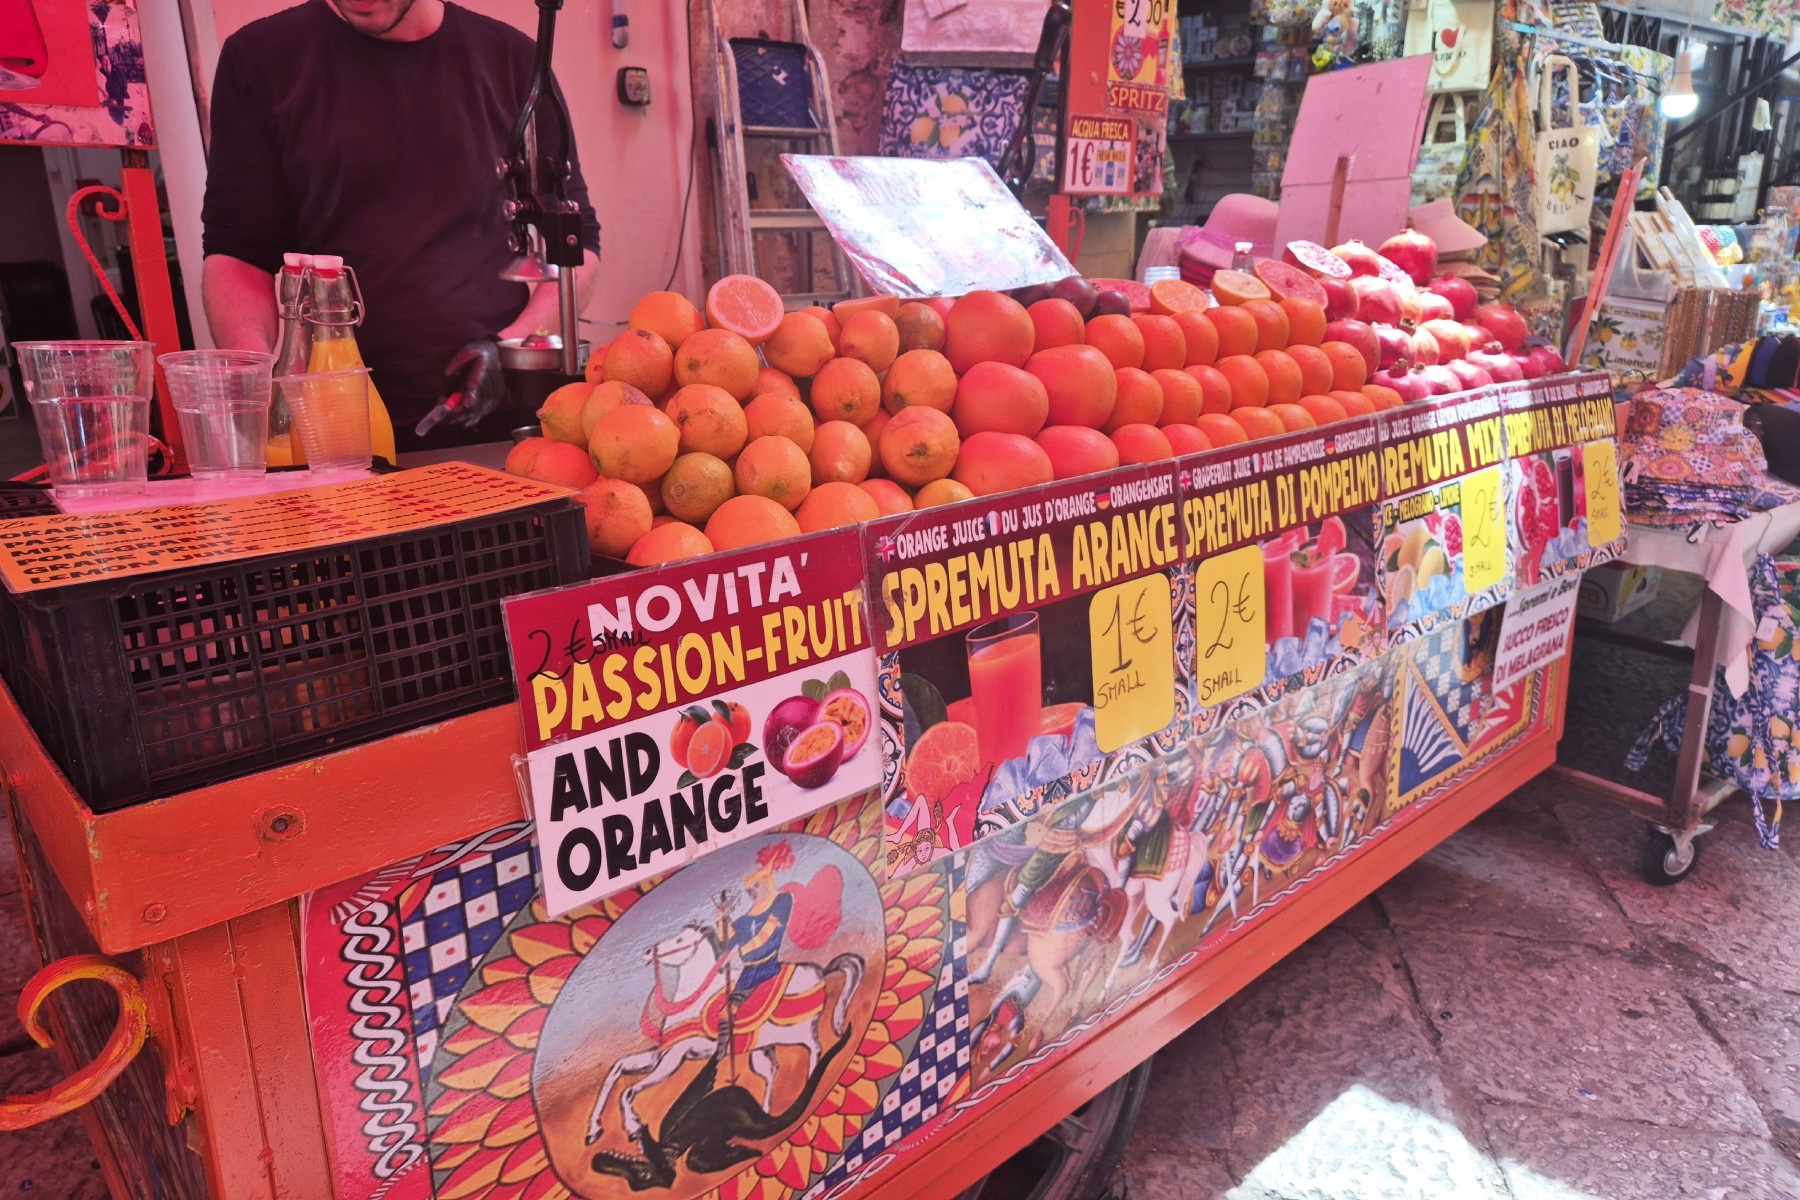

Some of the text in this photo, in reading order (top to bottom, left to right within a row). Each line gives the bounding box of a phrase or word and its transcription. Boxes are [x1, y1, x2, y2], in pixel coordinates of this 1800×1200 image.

[1110, 87, 1164, 111] SPRITZ
[1072, 120, 1129, 140] ACQUA FRESCA
[1549, 137, 1579, 150] CIAO
[1071, 141, 1095, 187] 1€
[1605, 350, 1656, 369] Limoncel
[1552, 406, 1567, 446] DI
[1565, 396, 1616, 442] MELOGRANO
[1193, 456, 1252, 490] GRAPEFRUIT JUICE
[1262, 450, 1274, 472] JUS
[1274, 448, 1283, 469] DE
[1380, 415, 1505, 496] REMUTA MIX
[1110, 474, 1173, 509] ORANGENSAFT
[1183, 450, 1379, 558] SPREMUTA DI POMPELMO
[1398, 490, 1435, 524] MELOGRANO
[0, 520, 132, 540] ORANGE
[142, 510, 221, 523] JUICE
[4, 527, 142, 549] PASSION
[153, 516, 232, 530] FRUIT
[1000, 491, 1096, 534] DU JUS D'ORANGE
[1470, 486, 1500, 548] 2€
[11, 544, 73, 557] MIX
[16, 530, 244, 566] POMEGRANTE
[23, 553, 137, 575] GRAPE
[147, 539, 235, 557] FRUIT
[896, 517, 985, 560] ORANGE JUICE
[30, 560, 160, 585] LEMON
[172, 544, 264, 562] JUICE
[882, 502, 1179, 648] SPREMUTA ARANCE
[586, 551, 810, 648] NOVITA'
[1205, 572, 1256, 659] 2€
[593, 627, 653, 655] SMALL
[1102, 586, 1158, 674] 1€
[1503, 606, 1569, 654] SUCCO FRESCO
[533, 589, 863, 741] PASSION-FRUIT
[1496, 632, 1565, 685] DI MELAGRANA
[1094, 670, 1146, 710] SMALL
[1201, 668, 1243, 702] SMALL
[550, 731, 661, 823] AND
[556, 760, 769, 892] ORANGE
